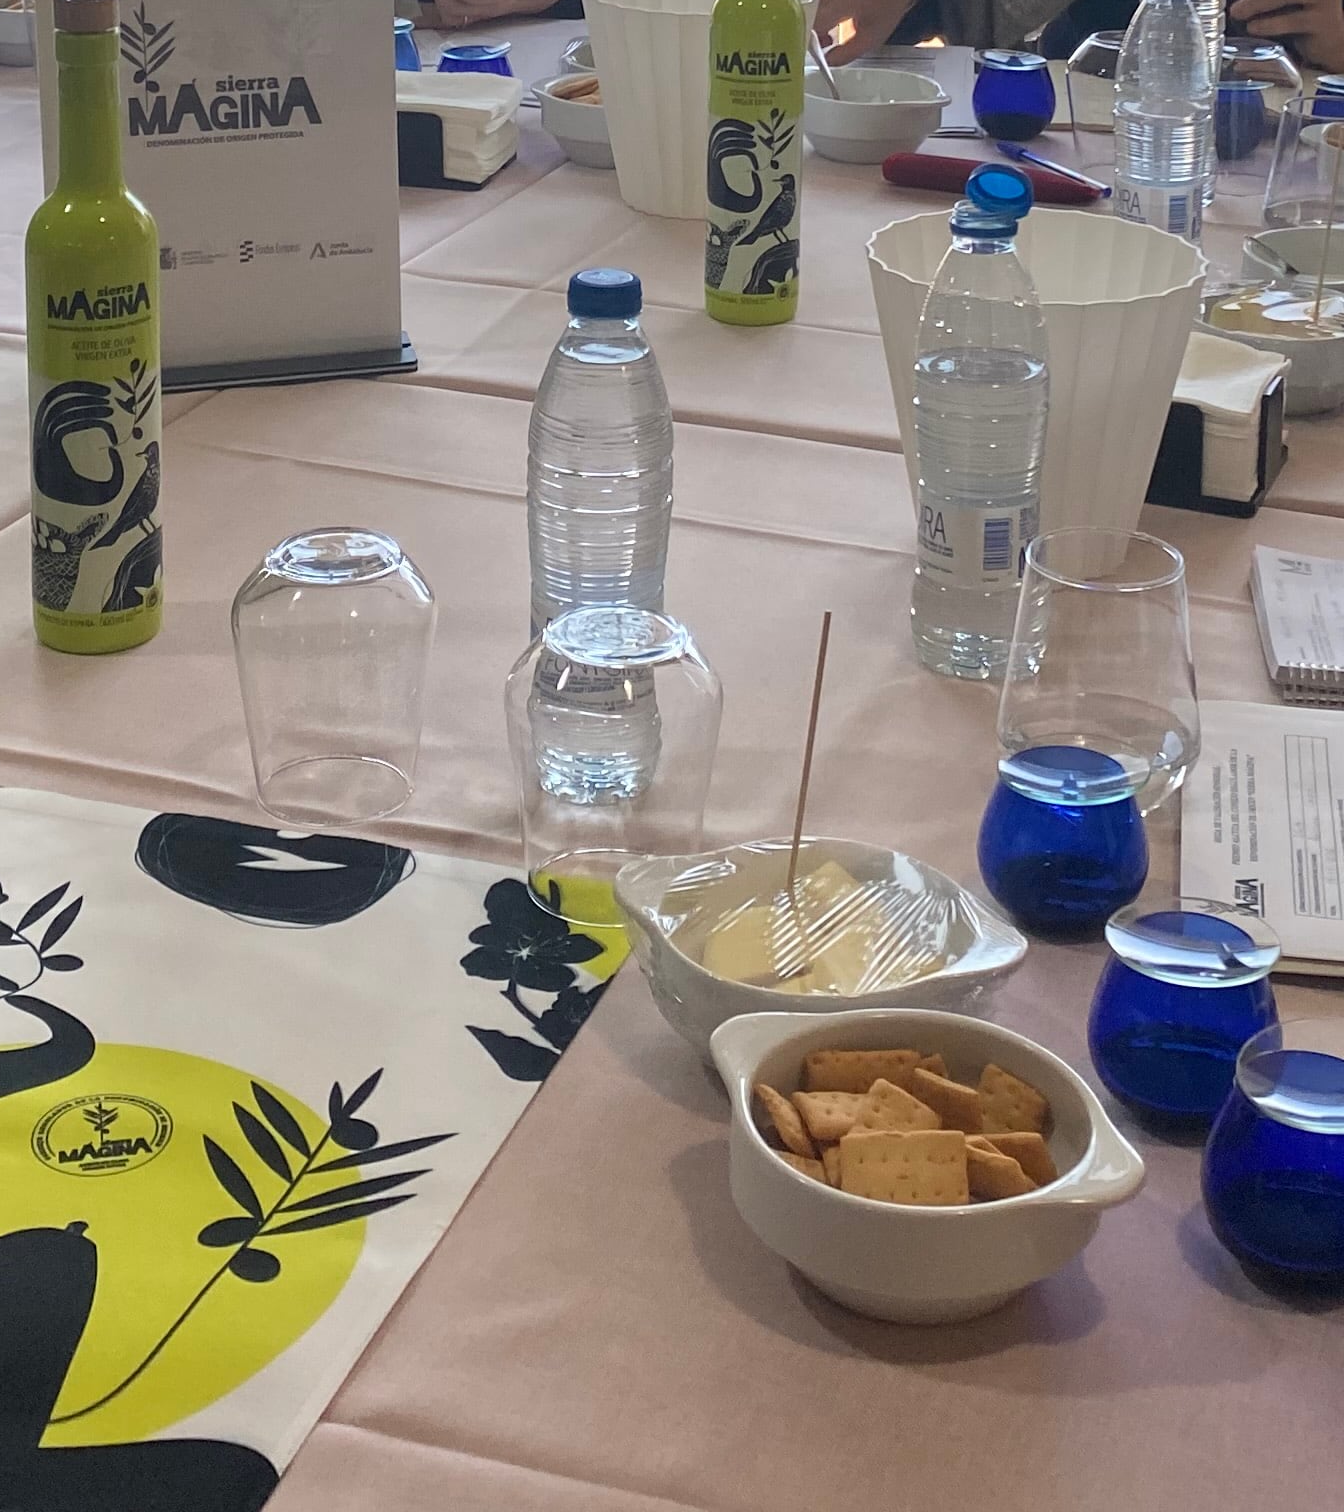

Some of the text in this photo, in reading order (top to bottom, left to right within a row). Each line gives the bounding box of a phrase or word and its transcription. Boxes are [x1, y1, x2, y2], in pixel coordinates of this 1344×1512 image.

[216, 75, 280, 93] sierra
[146, 131, 304, 148] DENOMINACIÓN DE ORIGEN PROTEGIDA
[97, 285, 133, 297] sierra
